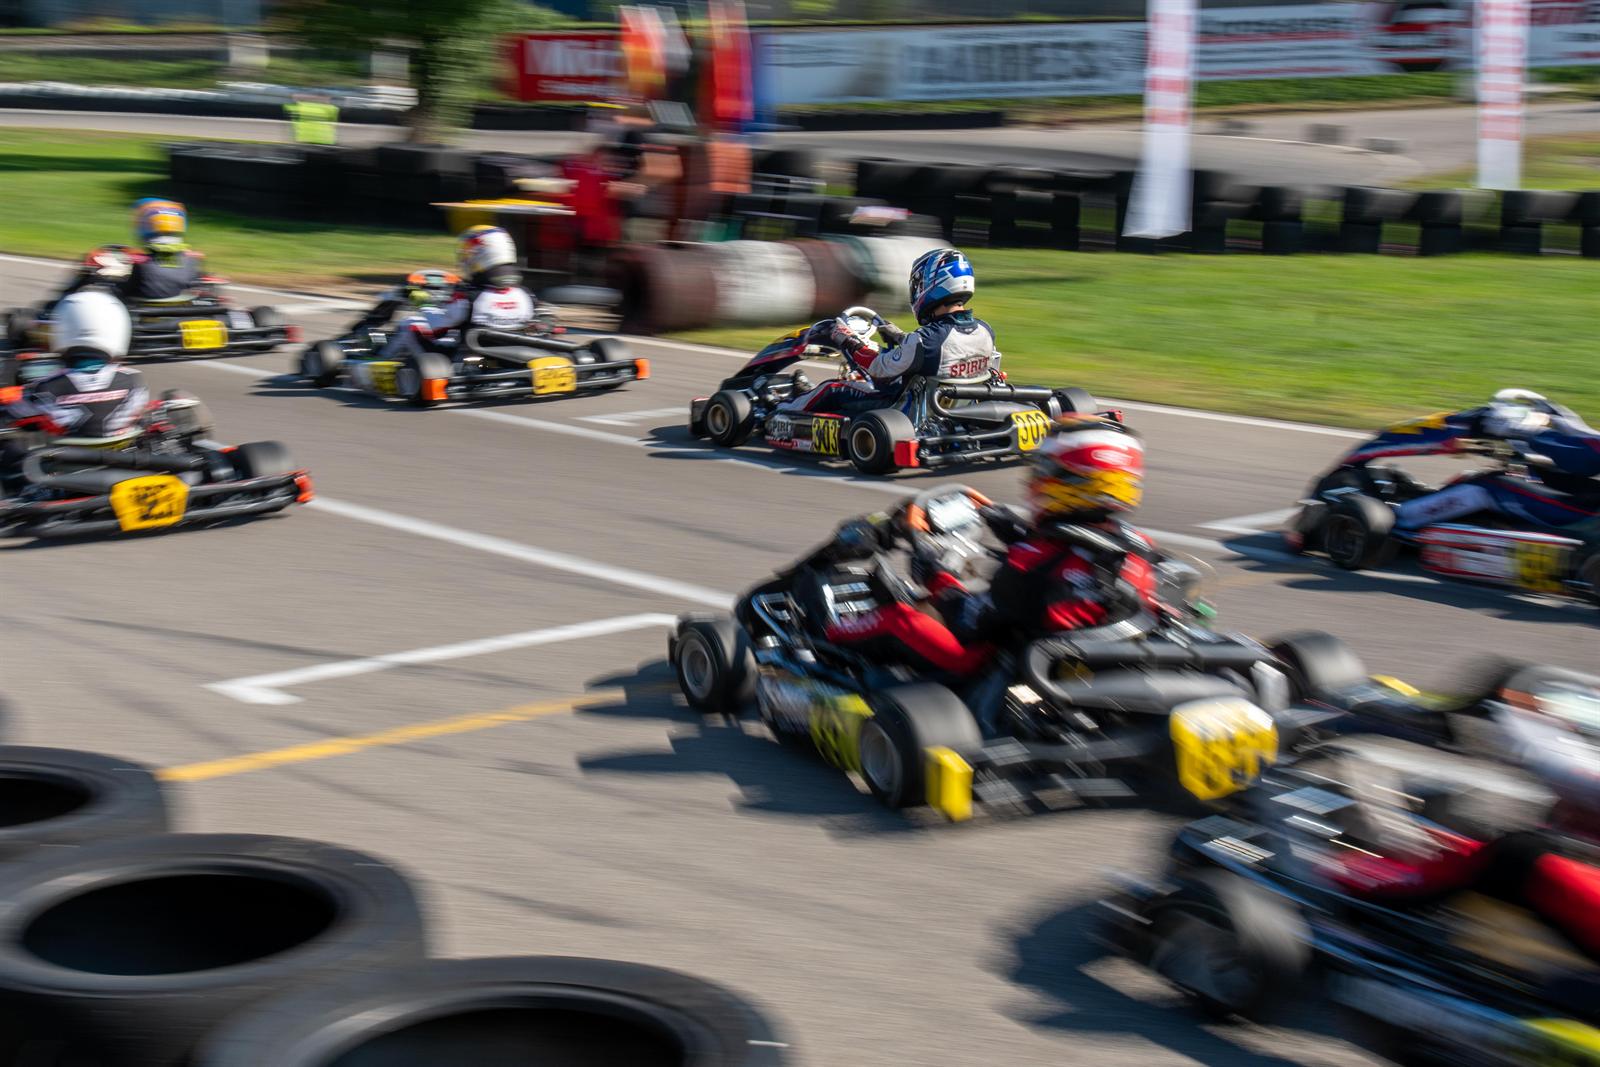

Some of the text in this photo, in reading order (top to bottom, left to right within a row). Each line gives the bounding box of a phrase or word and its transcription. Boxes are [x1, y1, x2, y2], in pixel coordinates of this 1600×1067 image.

[950, 356, 990, 378] SPIRIT
[812, 418, 839, 453] 303
[1015, 412, 1049, 445] 303
